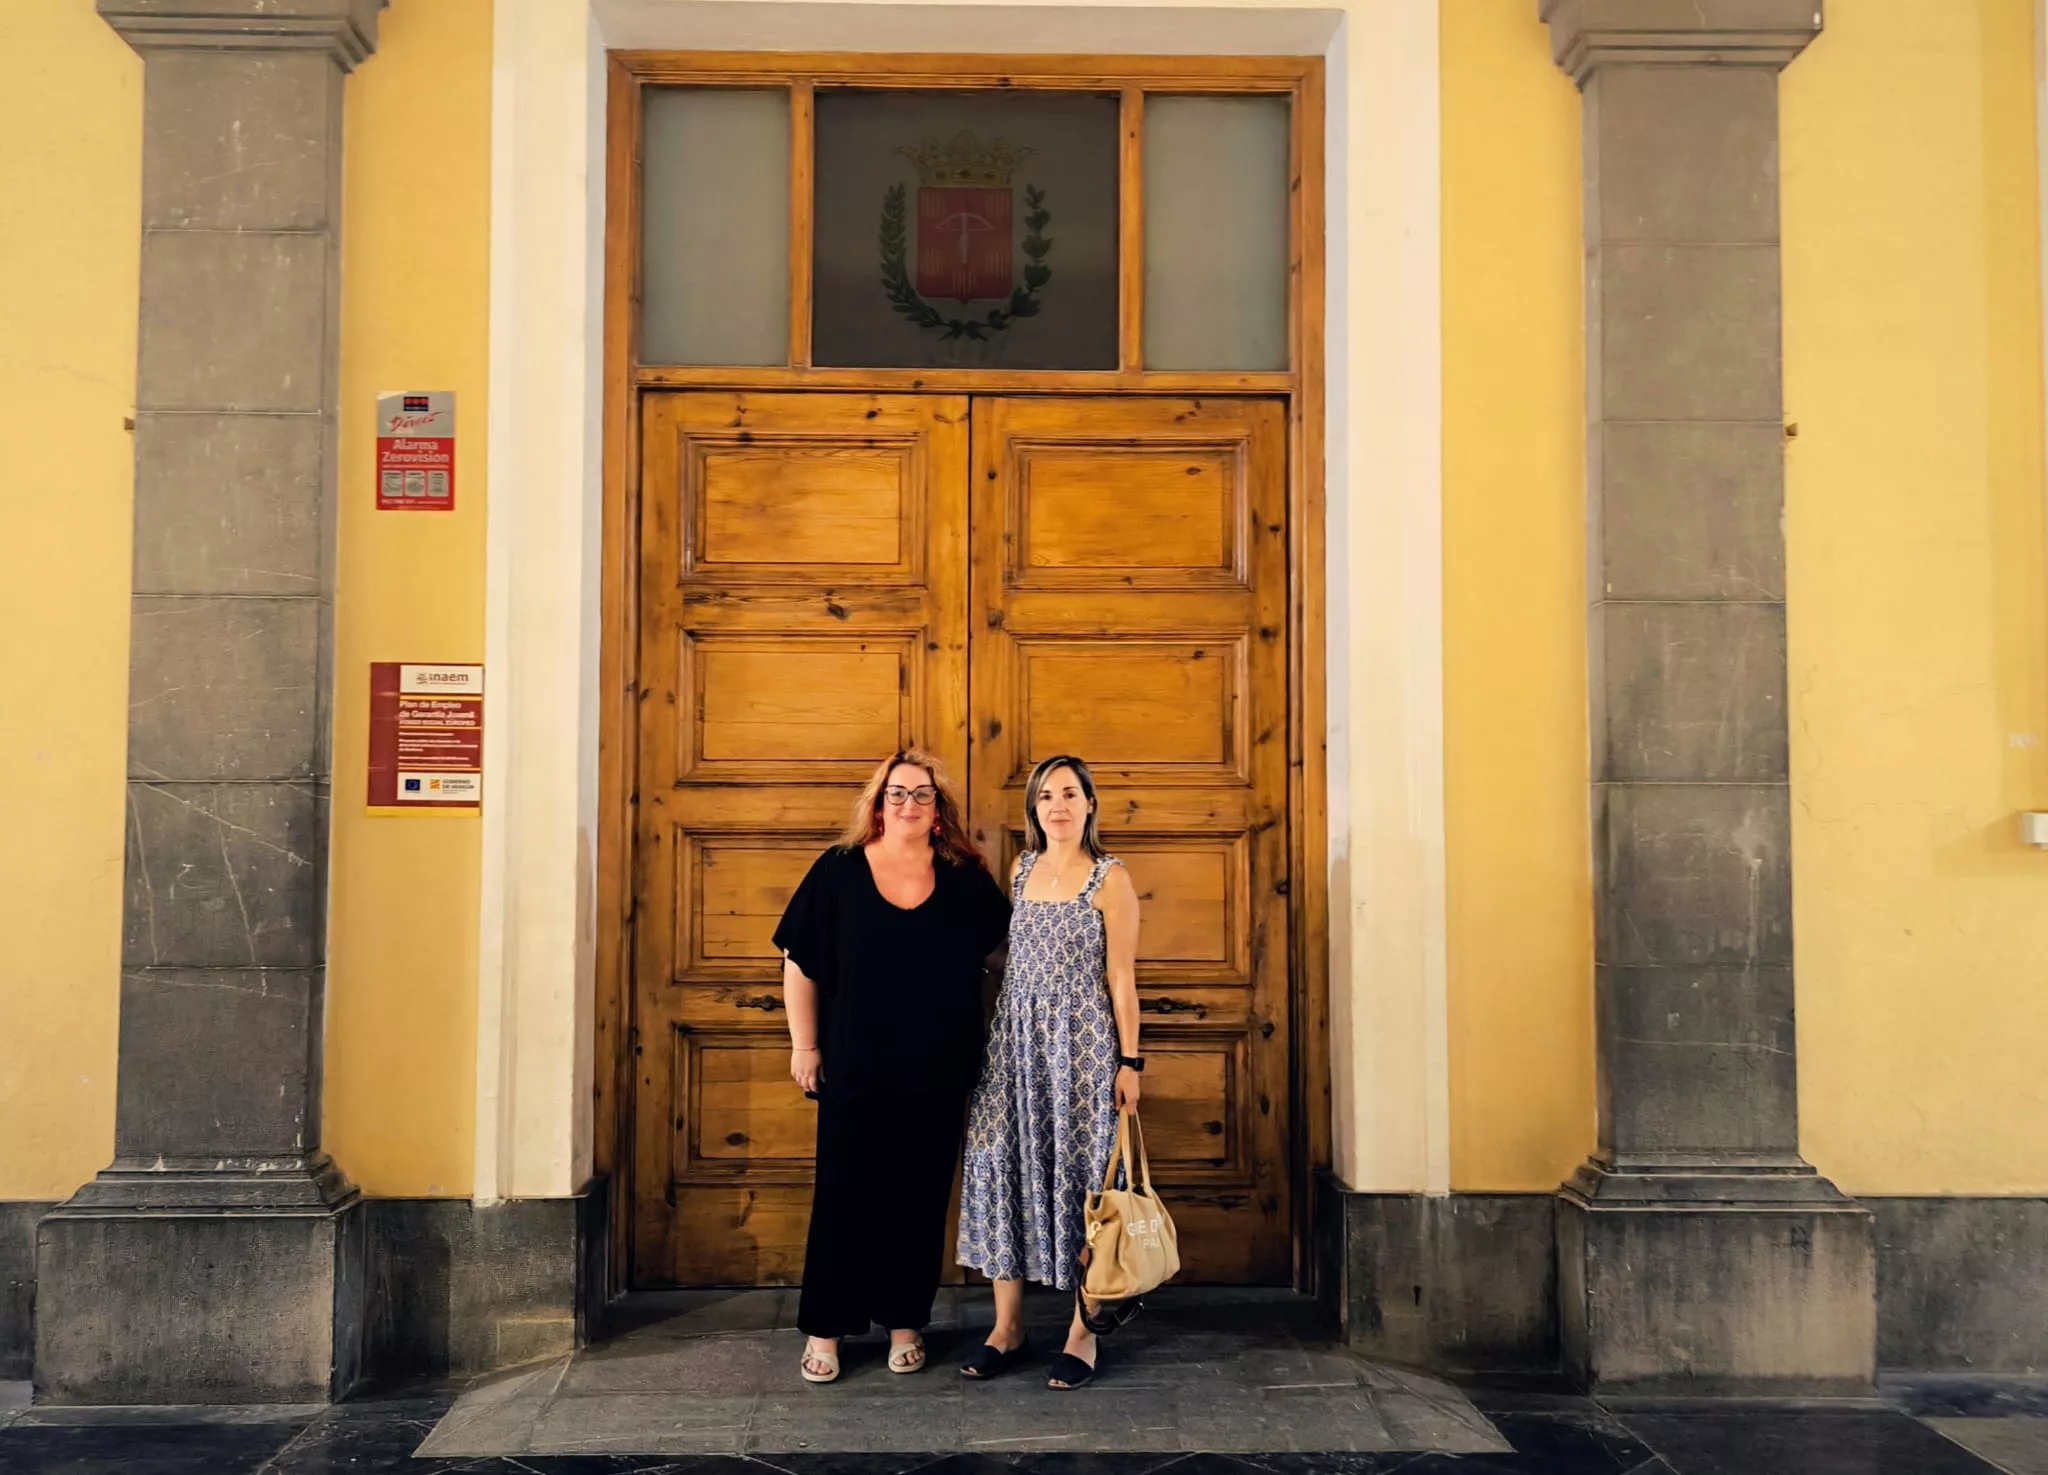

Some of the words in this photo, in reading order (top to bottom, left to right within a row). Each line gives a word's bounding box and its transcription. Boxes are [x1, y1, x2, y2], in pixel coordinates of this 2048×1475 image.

[392, 439, 438, 450] Alarma
[382, 451, 449, 462] Zerovision
[429, 673, 468, 682] inaem
[400, 700, 417, 708] Plan
[431, 701, 462, 709] Empleo
[399, 710, 410, 718] de
[446, 711, 475, 719] Juvenil
